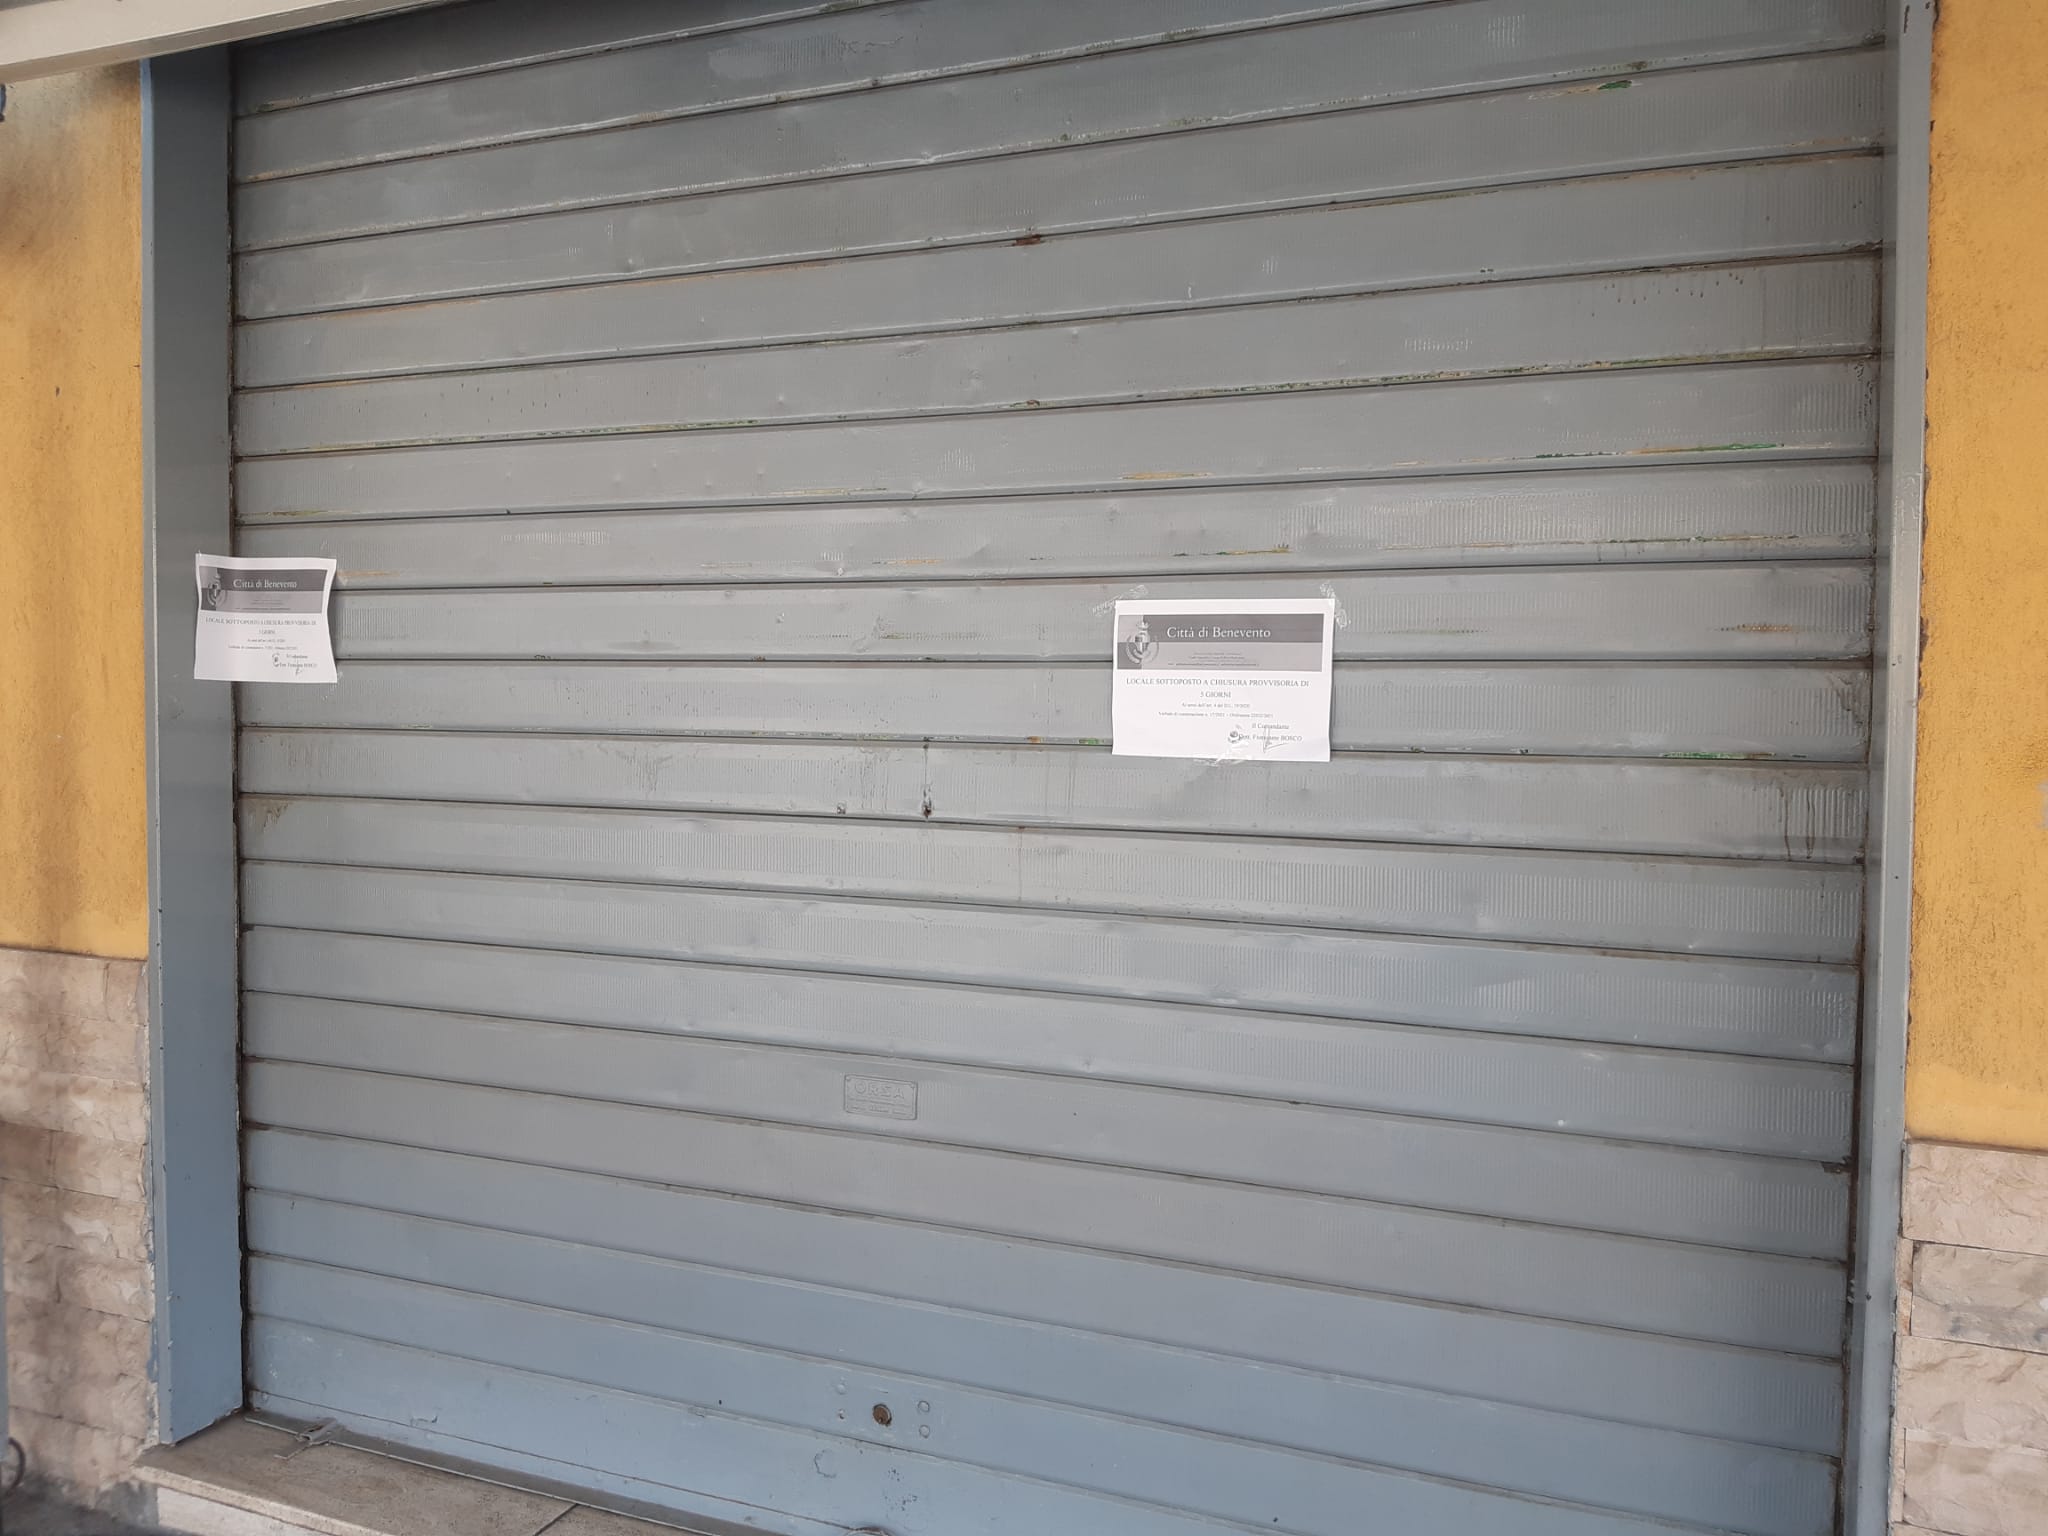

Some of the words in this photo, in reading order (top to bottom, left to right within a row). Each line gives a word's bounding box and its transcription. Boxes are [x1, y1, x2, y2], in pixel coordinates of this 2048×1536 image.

[1166, 626, 1194, 639] Città
[1198, 626, 1210, 638] di
[1212, 626, 1272, 639] Benevento
[1126, 677, 1154, 686] LOCALE
[1155, 677, 1203, 686] SOTTOPOSTO
[1203, 678, 1209, 686] A
[1210, 678, 1248, 687] CHIUSURA
[1249, 679, 1299, 688] PROVVISORIA
[1300, 680, 1310, 688] DI
